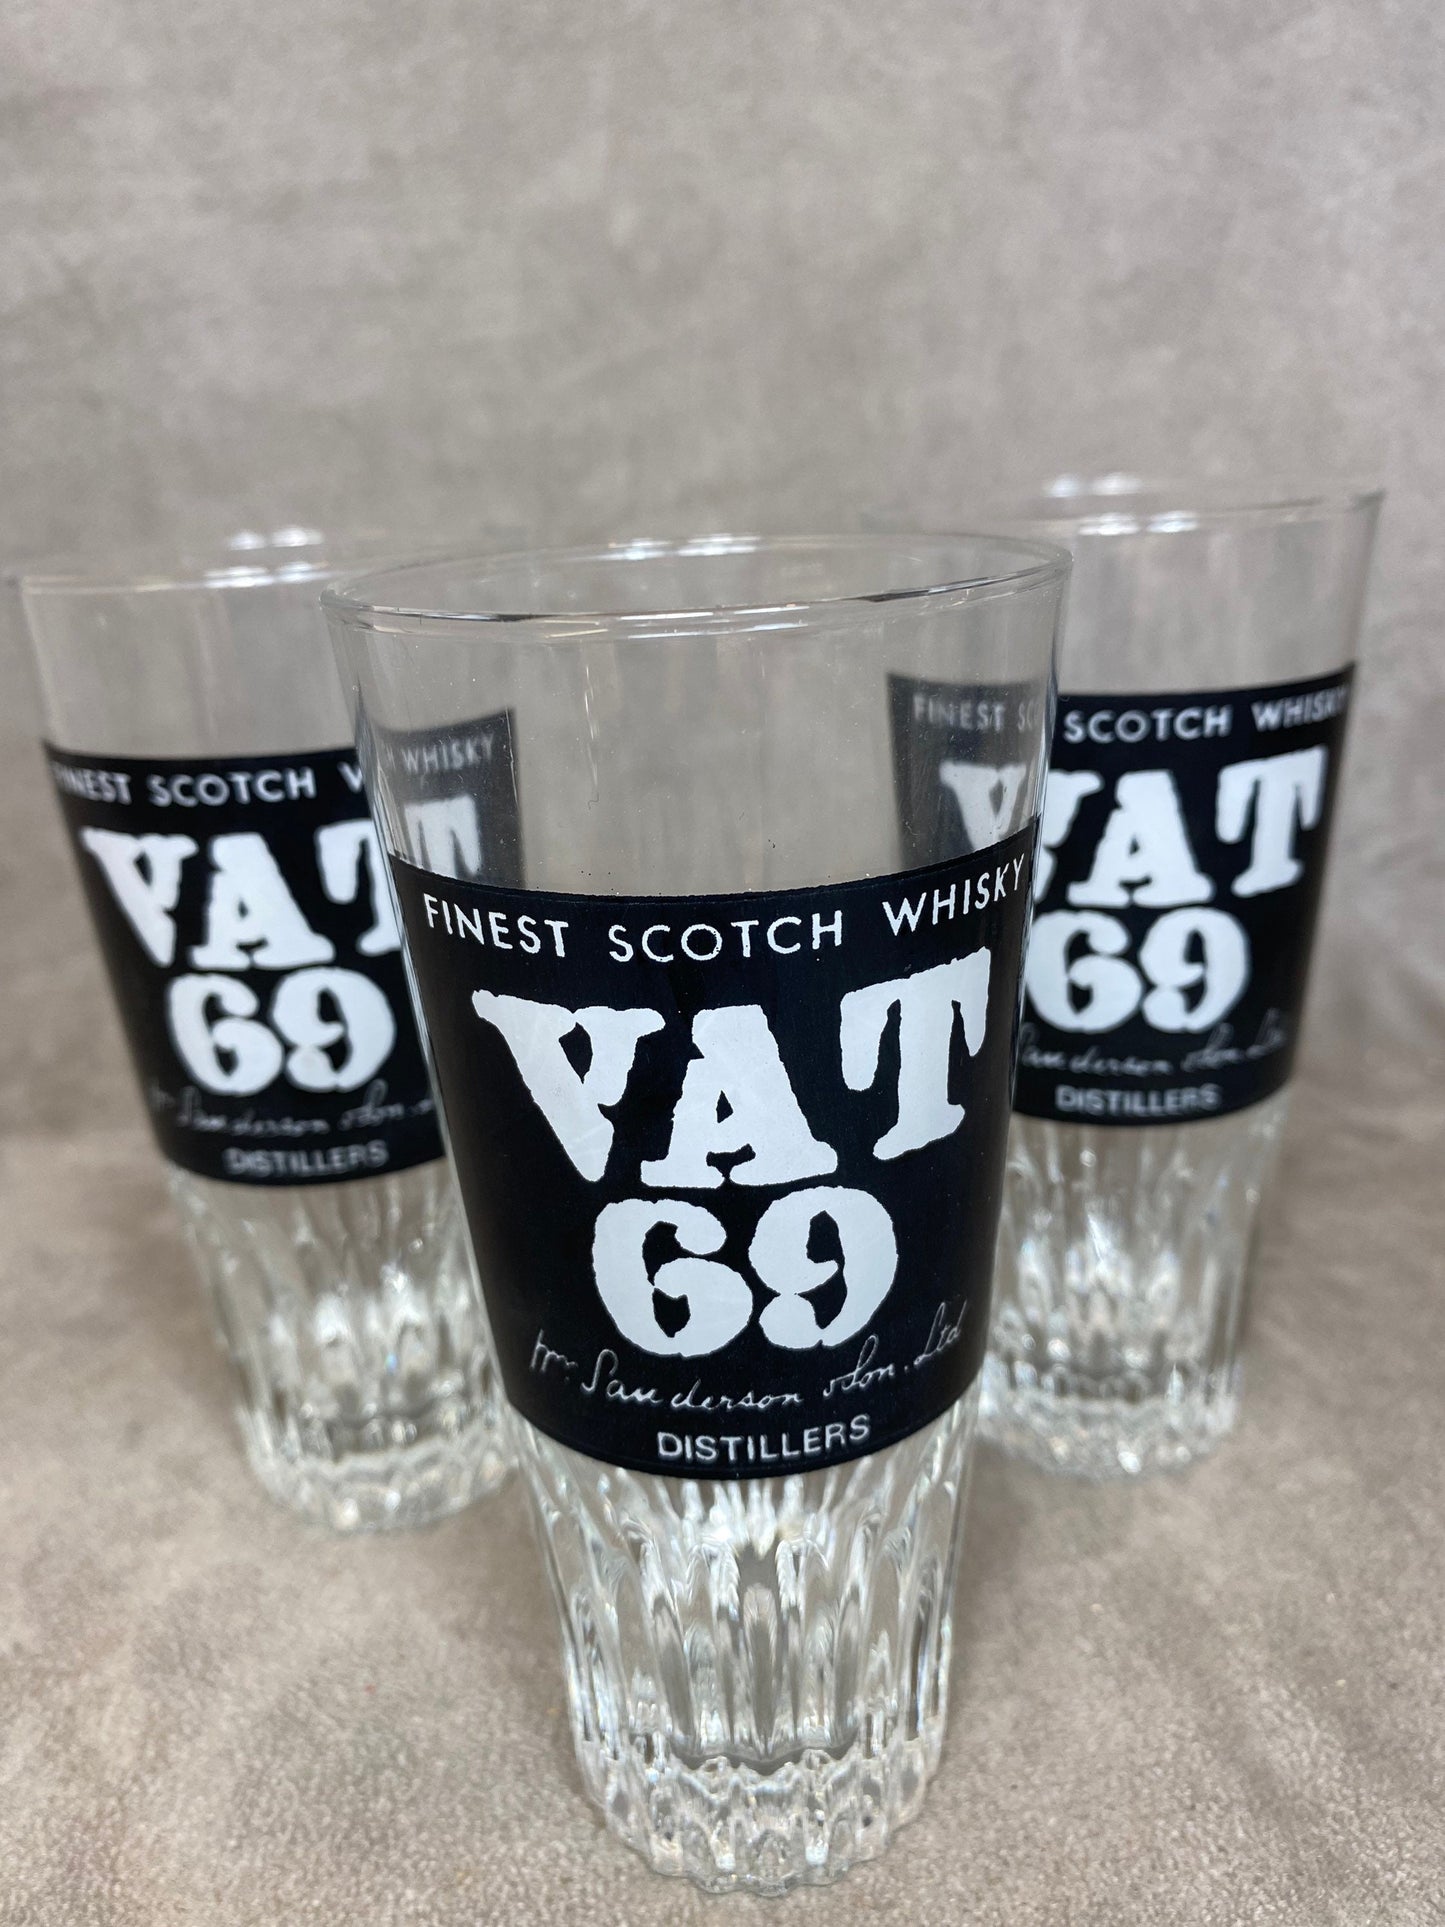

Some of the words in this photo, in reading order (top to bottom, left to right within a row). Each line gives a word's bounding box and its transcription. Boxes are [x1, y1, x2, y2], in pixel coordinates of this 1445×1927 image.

[912, 694, 1005, 732] FINEST
[1063, 704, 1232, 743] SCOTCH
[402, 732, 494, 774] WHISKY
[147, 767, 316, 807] SCOTCH
[423, 893, 569, 957] FINEST
[608, 910, 844, 963] SCOTCH
[882, 853, 1026, 937] WHISKY
[1025, 908, 1252, 1033] 69
[165, 967, 396, 1096] 69
[471, 946, 992, 1189] VAT
[1055, 1083, 1222, 1117] DISTILLERS
[223, 1140, 389, 1178] DISTILLERS
[592, 1186, 898, 1357] 69
[657, 1415, 870, 1463] DISTILLERS
